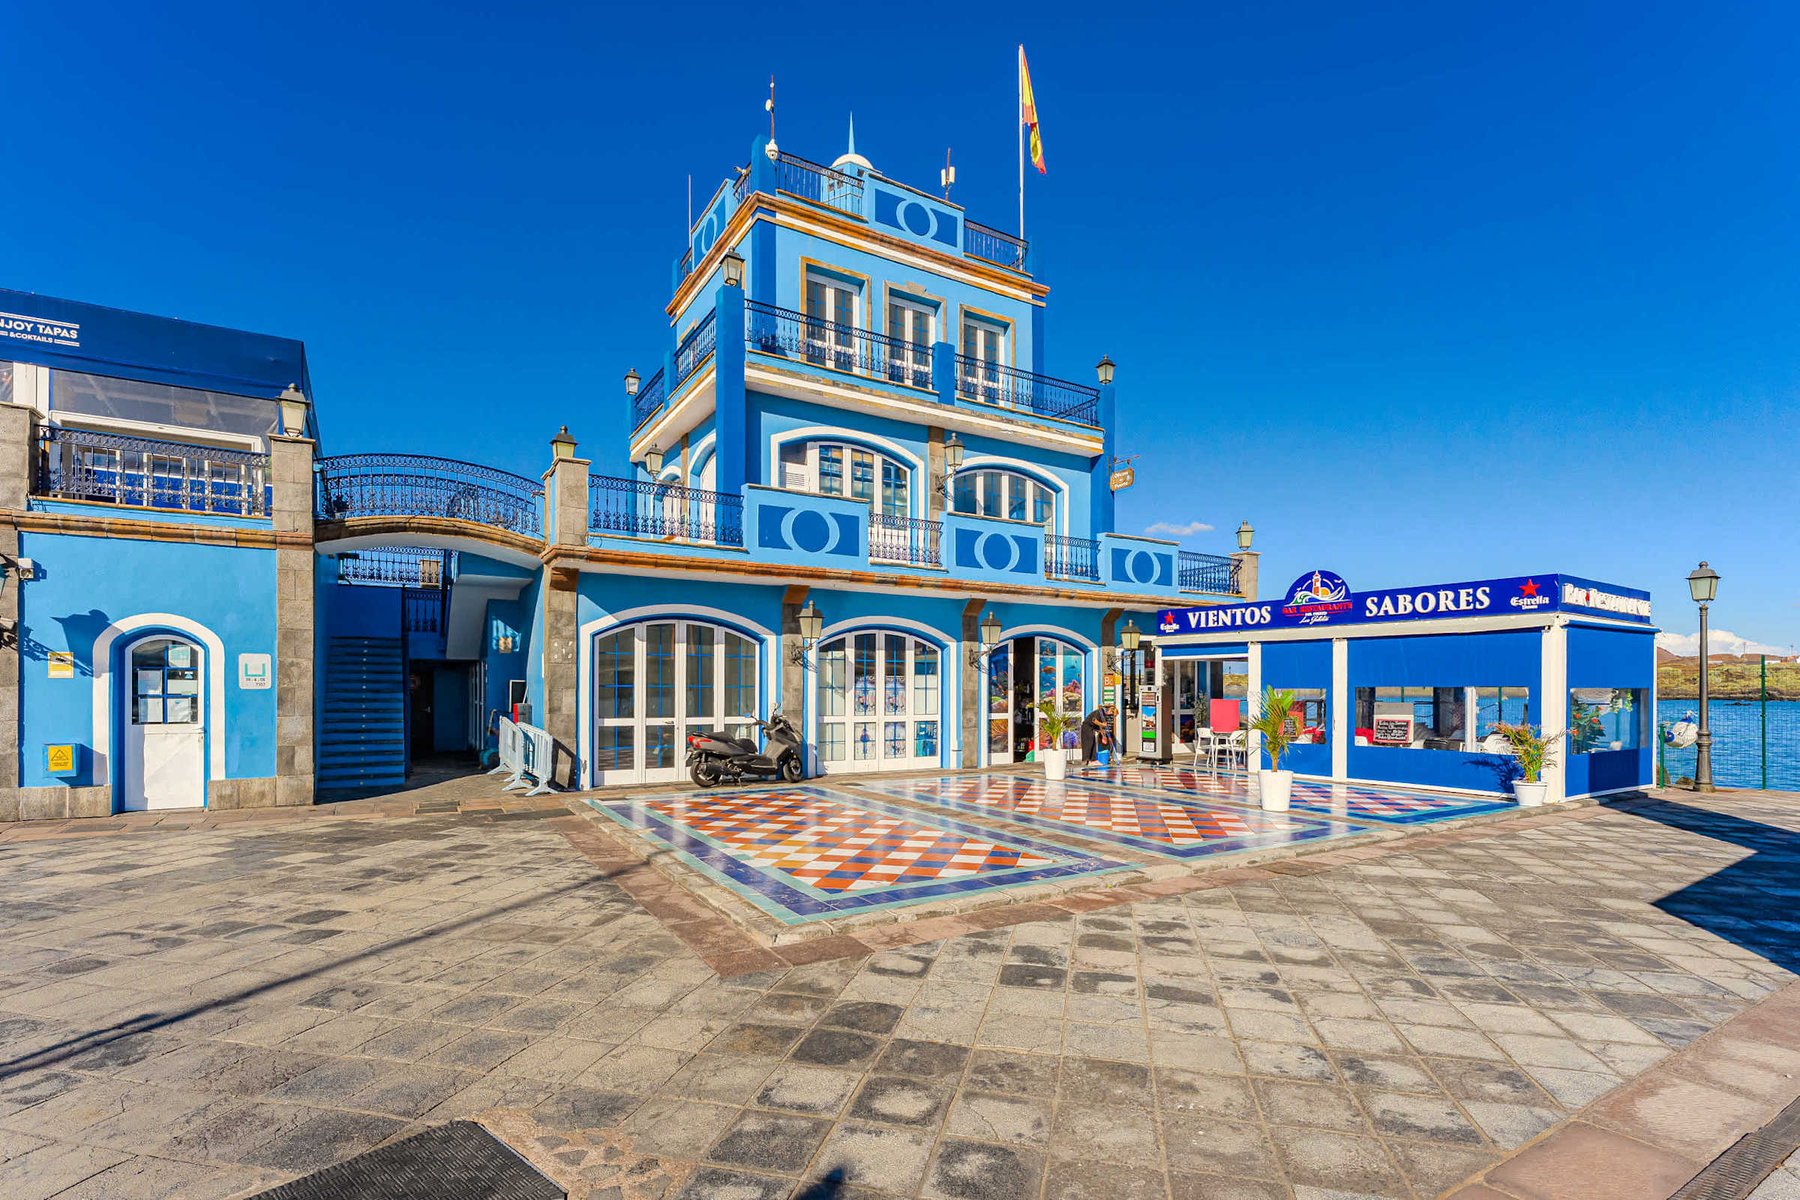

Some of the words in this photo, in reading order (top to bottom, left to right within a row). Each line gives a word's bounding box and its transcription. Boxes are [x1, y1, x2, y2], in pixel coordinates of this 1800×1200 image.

[37, 324, 78, 339] TAPAS
[1365, 586, 1491, 617] SABORES
[1510, 595, 1550, 606] Estrella
[1187, 606, 1271, 629] VIENTOS
